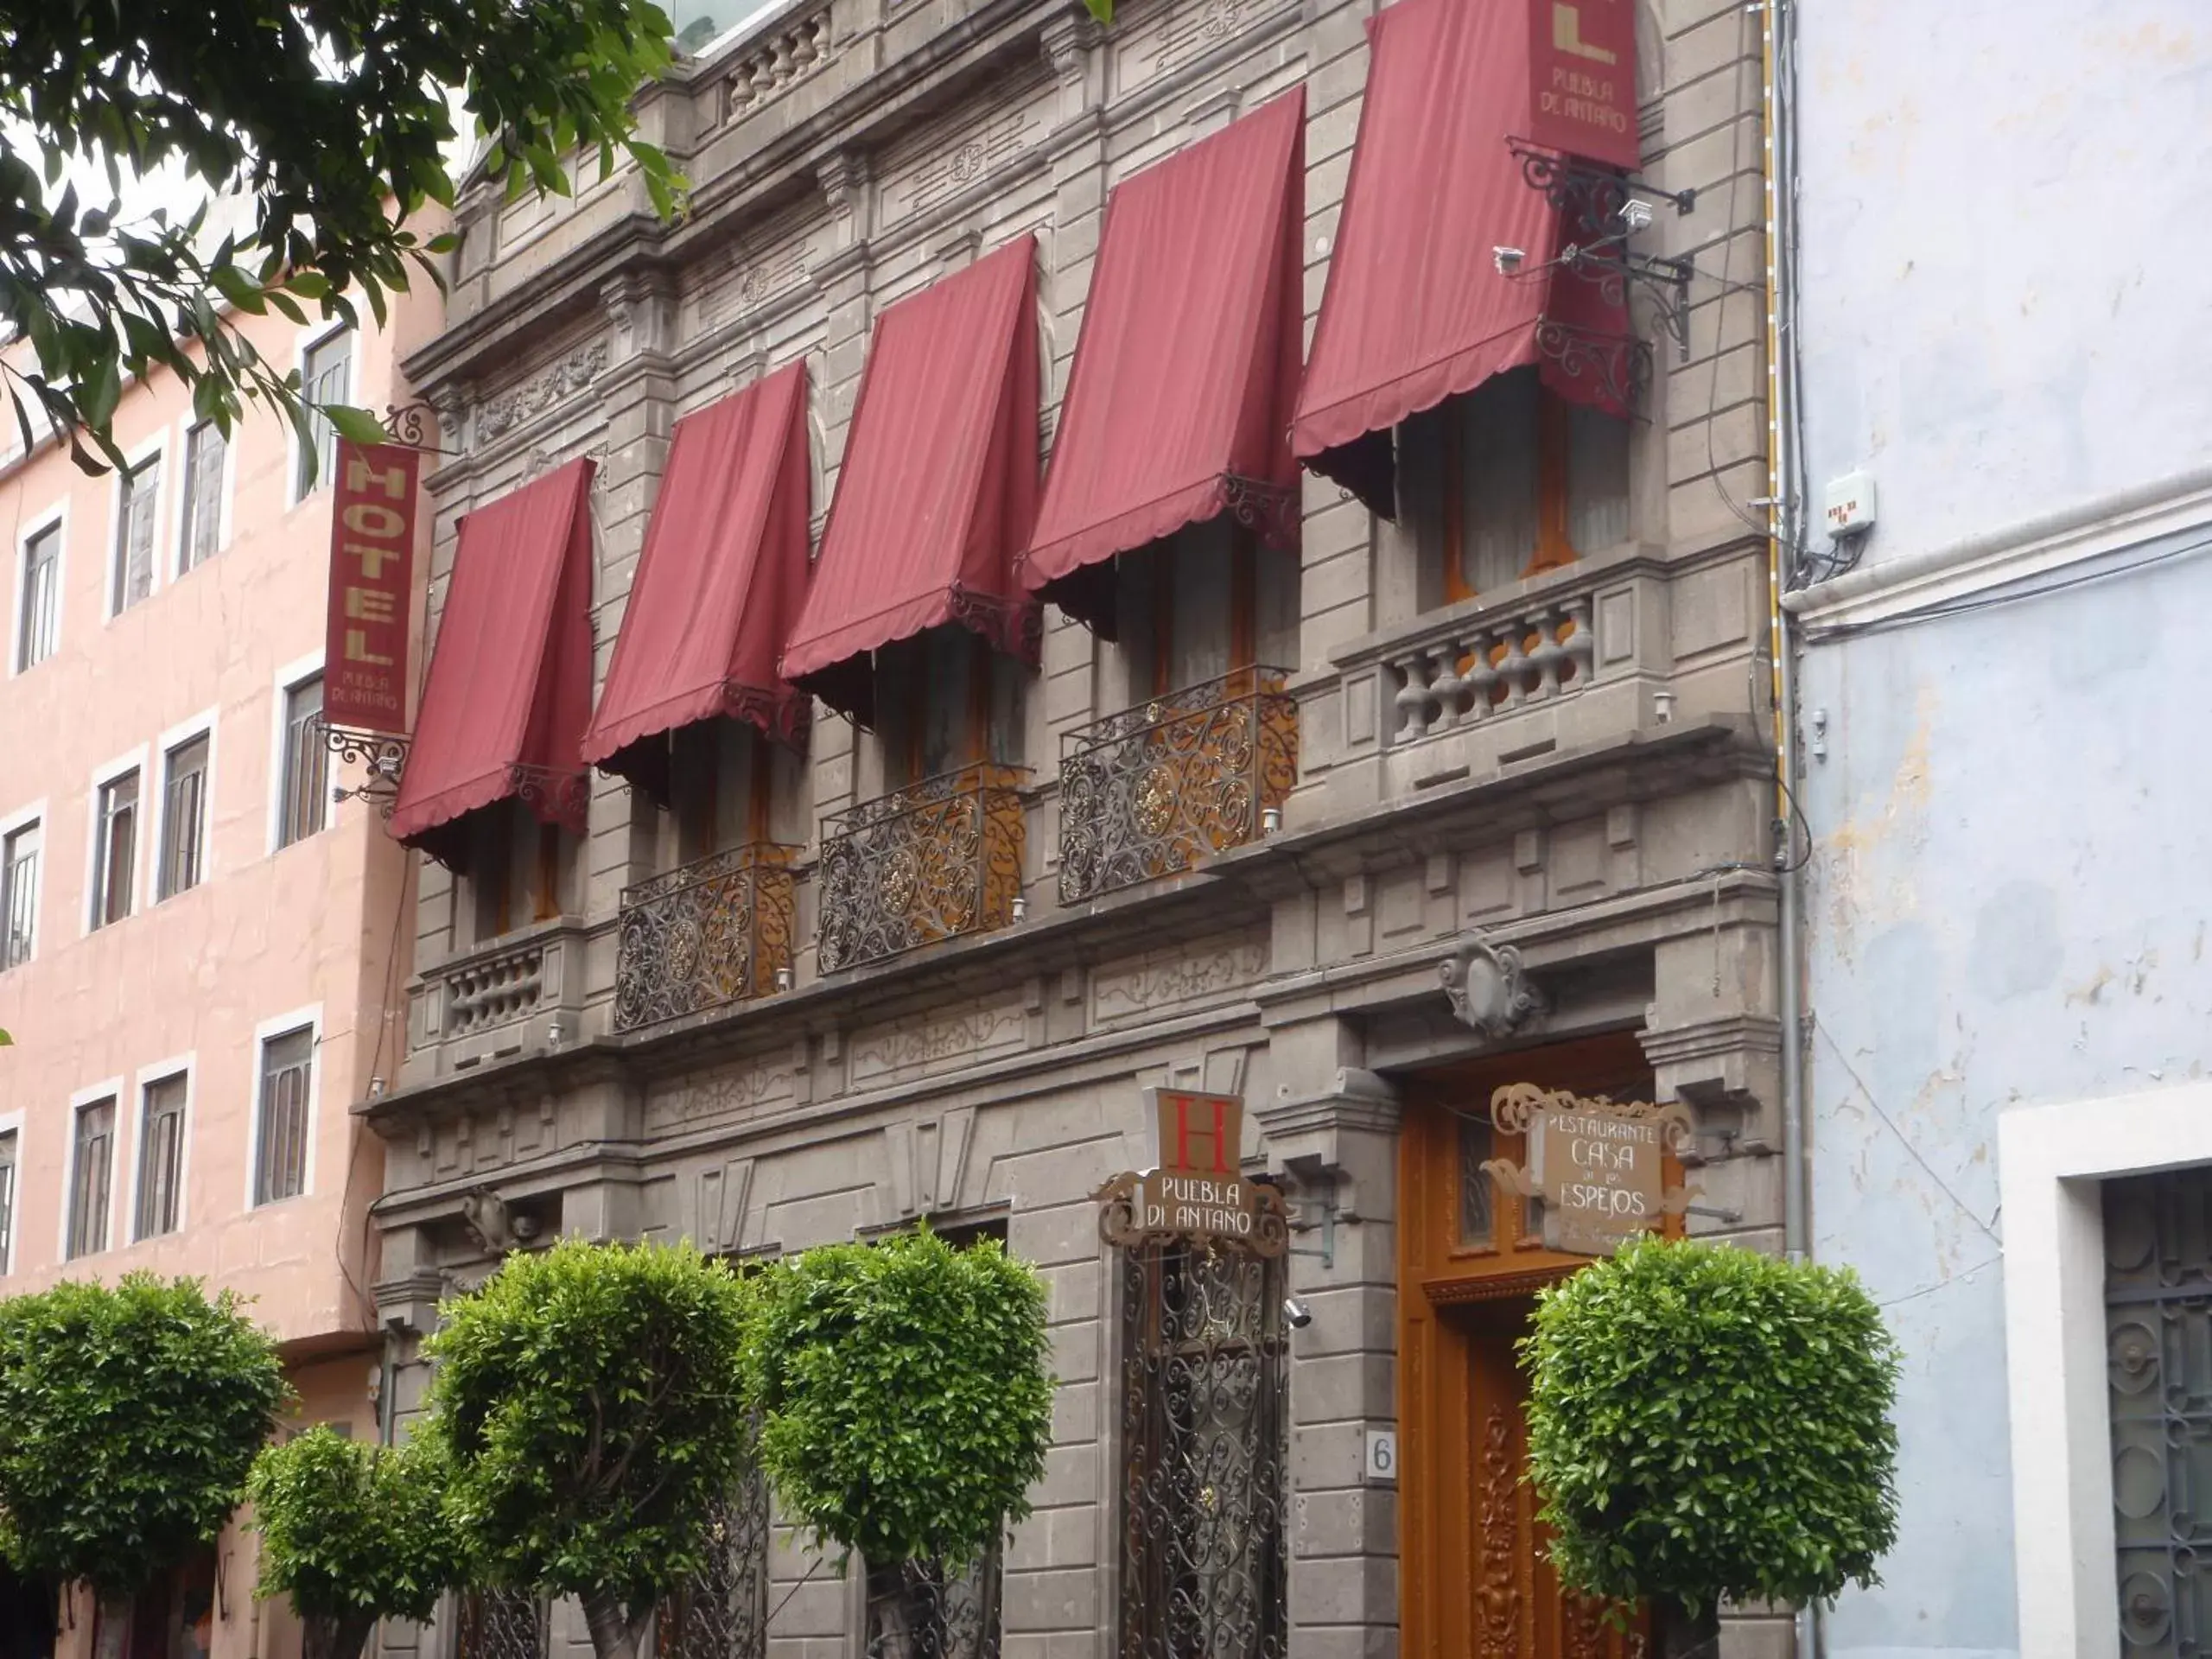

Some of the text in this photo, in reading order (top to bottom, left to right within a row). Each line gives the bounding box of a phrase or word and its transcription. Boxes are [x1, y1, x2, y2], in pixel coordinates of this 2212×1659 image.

[1552, 67, 1614, 103] PUEBLA
[342, 459, 406, 667] HOTEL
[1166, 1094, 1234, 1174] H
[1548, 1114, 1656, 1144] RESTAURANTE
[1571, 1137, 1634, 1170] CASA
[1161, 1176, 1241, 1206] PUEBLA
[1560, 1182, 1646, 1220] ESPEJOS
[1175, 1205, 1252, 1235] ANTAÑO
[1373, 1438, 1392, 1471] 6
